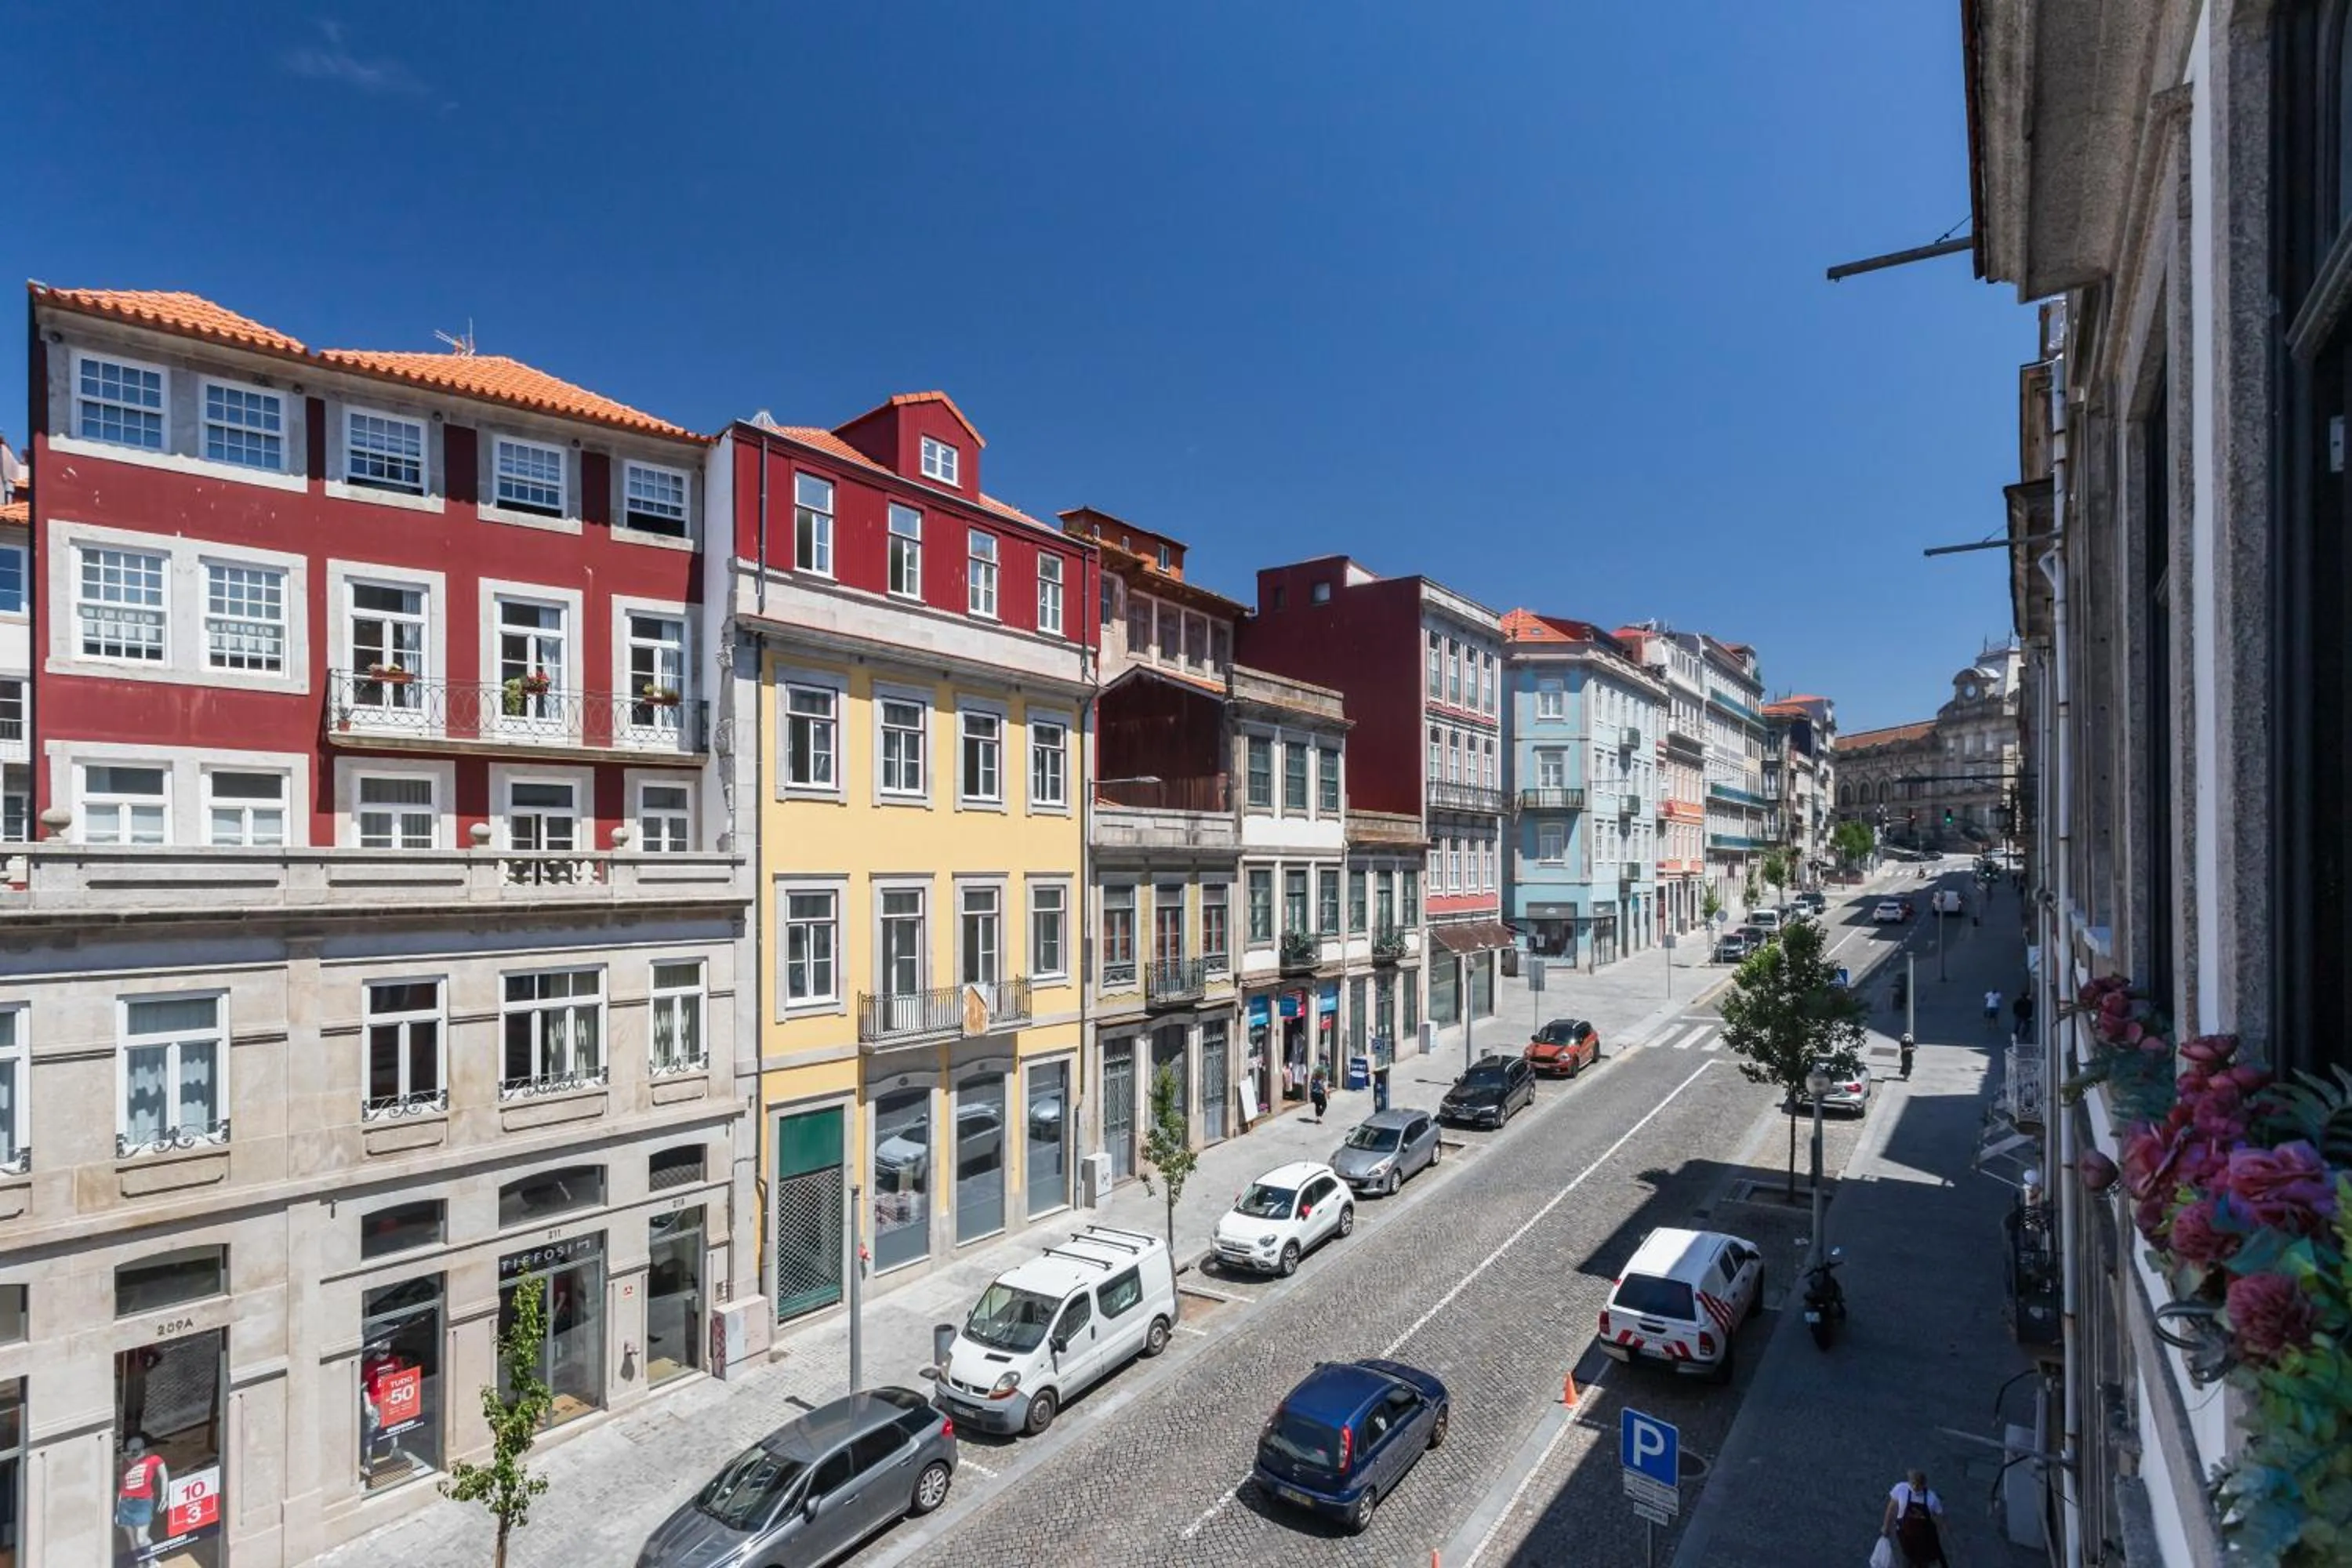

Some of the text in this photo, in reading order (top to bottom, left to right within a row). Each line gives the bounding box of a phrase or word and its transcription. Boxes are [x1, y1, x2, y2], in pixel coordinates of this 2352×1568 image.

[158, 1317, 194, 1337] 209A
[1633, 1418, 1665, 1467] P
[181, 1480, 205, 1501] 10
[185, 1507, 201, 1525] 3
